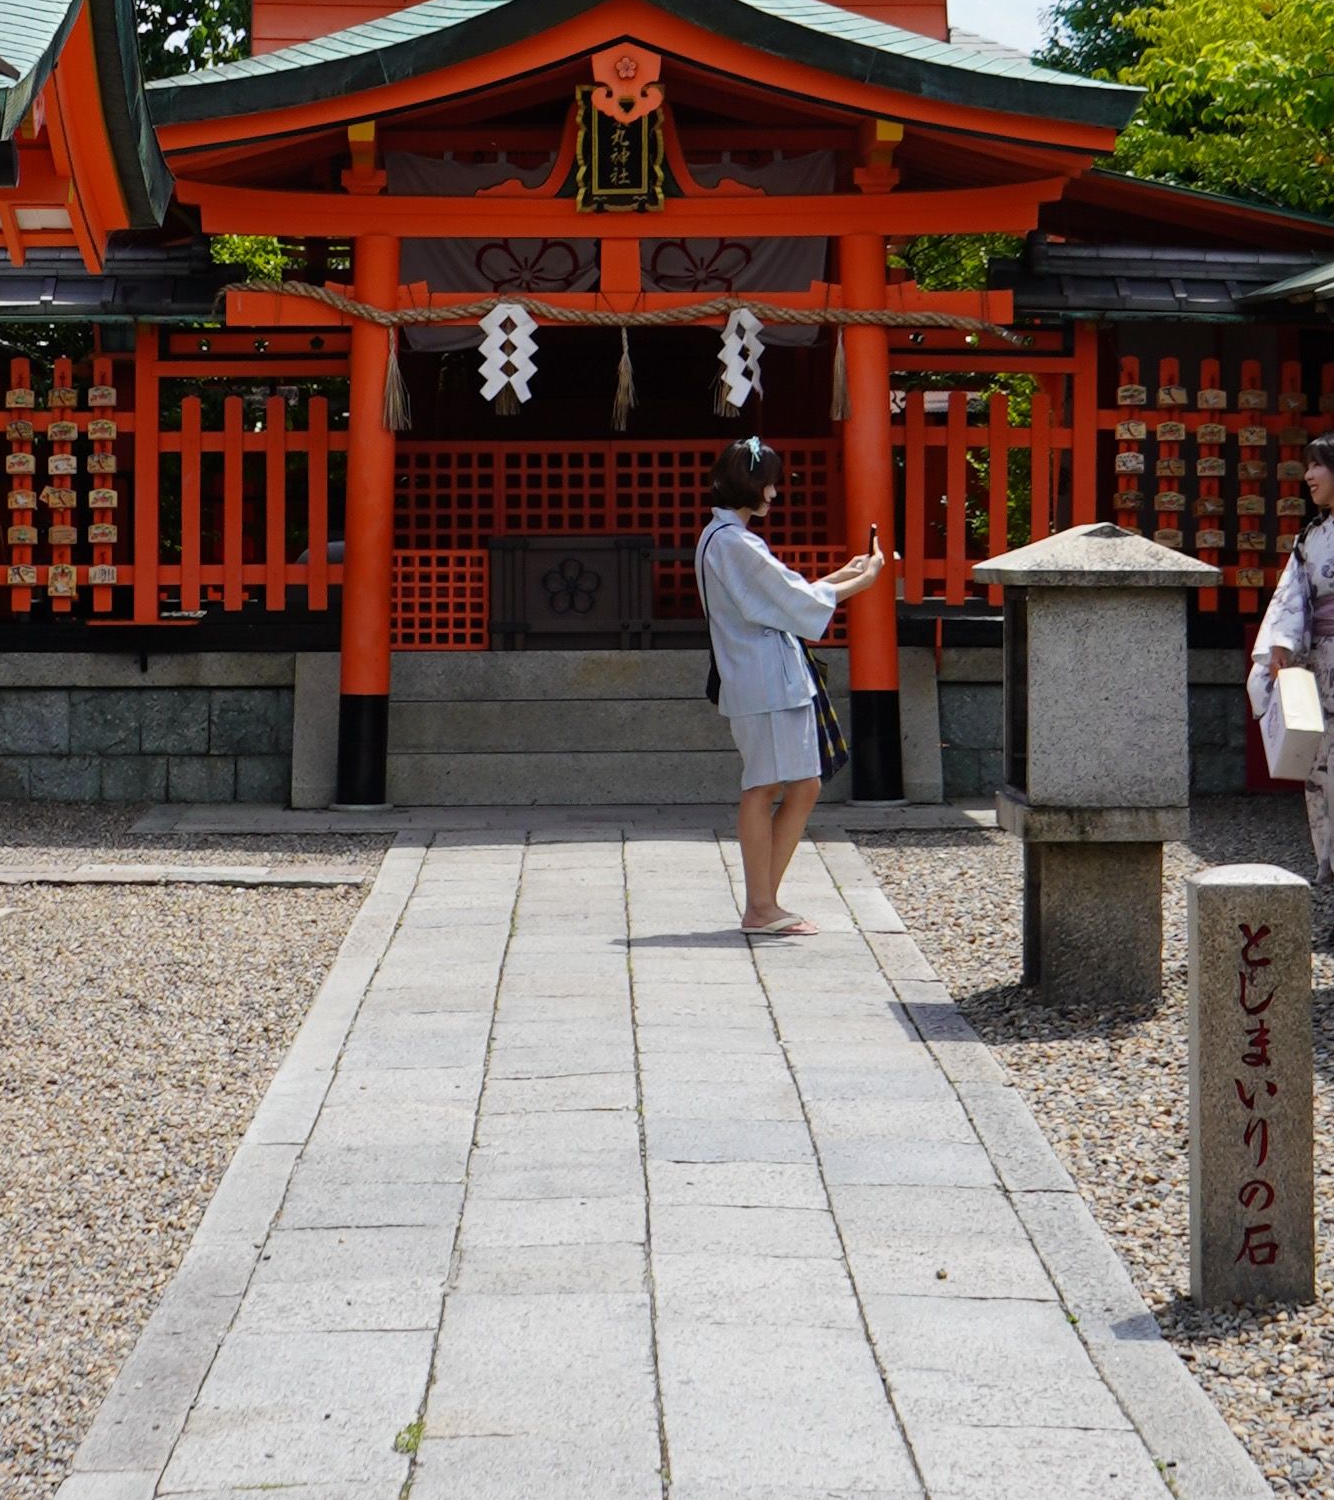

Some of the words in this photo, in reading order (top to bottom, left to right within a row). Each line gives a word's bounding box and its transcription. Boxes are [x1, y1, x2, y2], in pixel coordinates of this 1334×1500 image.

[609, 121, 631, 186] 丸神社
[1235, 923, 1278, 1265] としまいりの石
